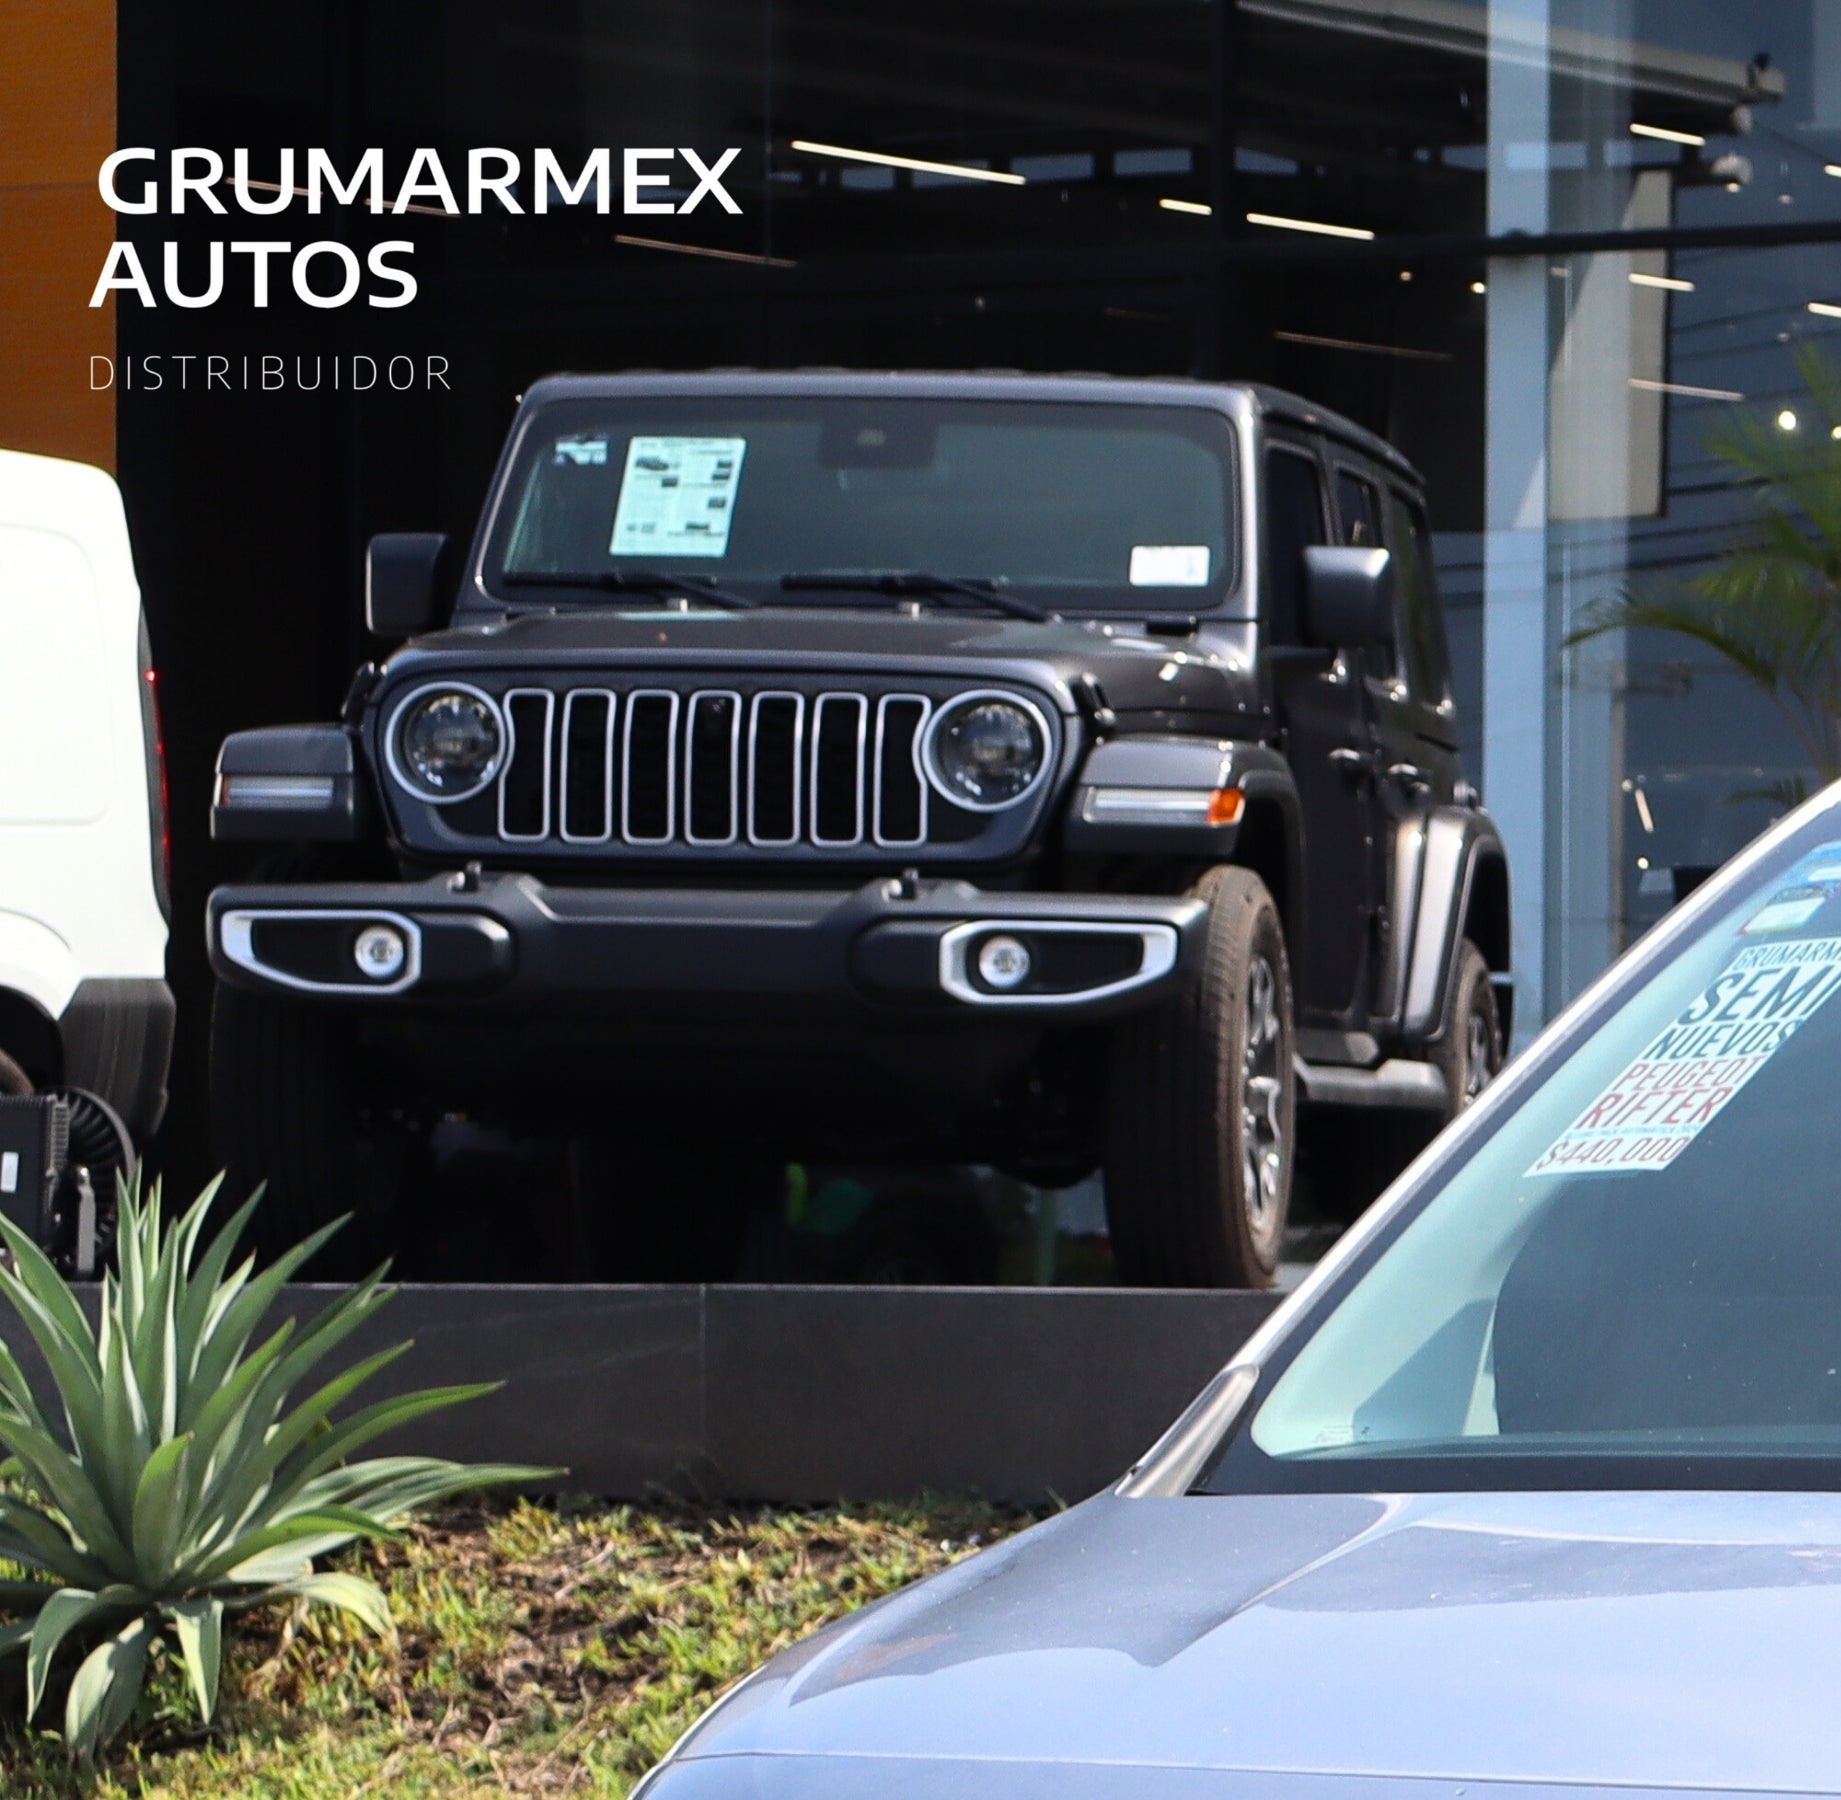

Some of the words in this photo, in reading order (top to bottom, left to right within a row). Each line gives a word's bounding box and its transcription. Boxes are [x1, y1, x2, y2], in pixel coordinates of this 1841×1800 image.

[1643, 1019, 1804, 1060] NUEVOS
[1610, 1054, 1768, 1092] PEUGEOT
[1574, 1087, 1734, 1130] RIFTER
[1536, 1136, 1692, 1170] $440,000
